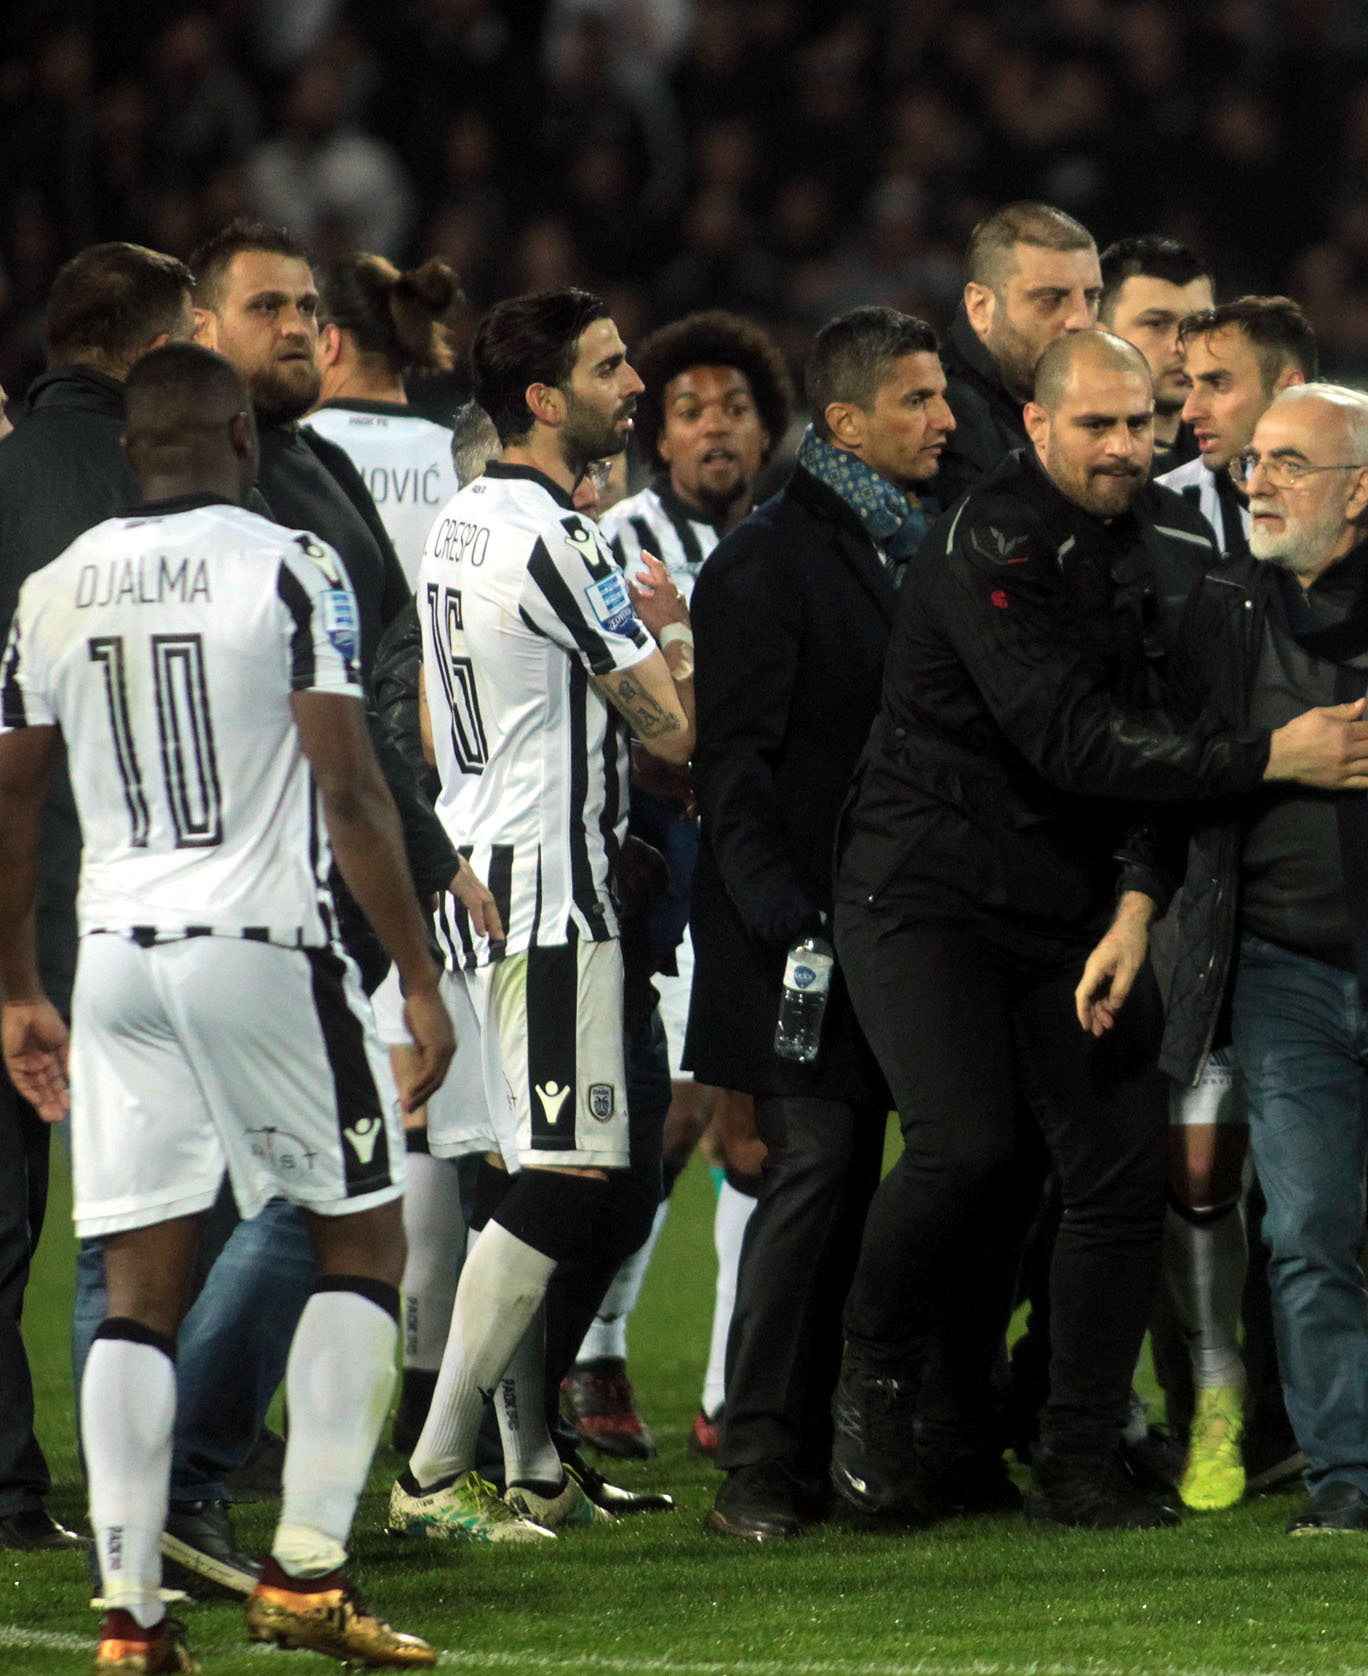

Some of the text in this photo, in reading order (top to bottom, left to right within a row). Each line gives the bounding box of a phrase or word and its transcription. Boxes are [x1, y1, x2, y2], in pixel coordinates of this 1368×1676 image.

[361, 462, 440, 505] OVIĆ
[434, 518, 491, 568] CRESPO
[75, 556, 212, 609] DJALMA
[427, 582, 490, 776] 16
[88, 633, 223, 849] 10
